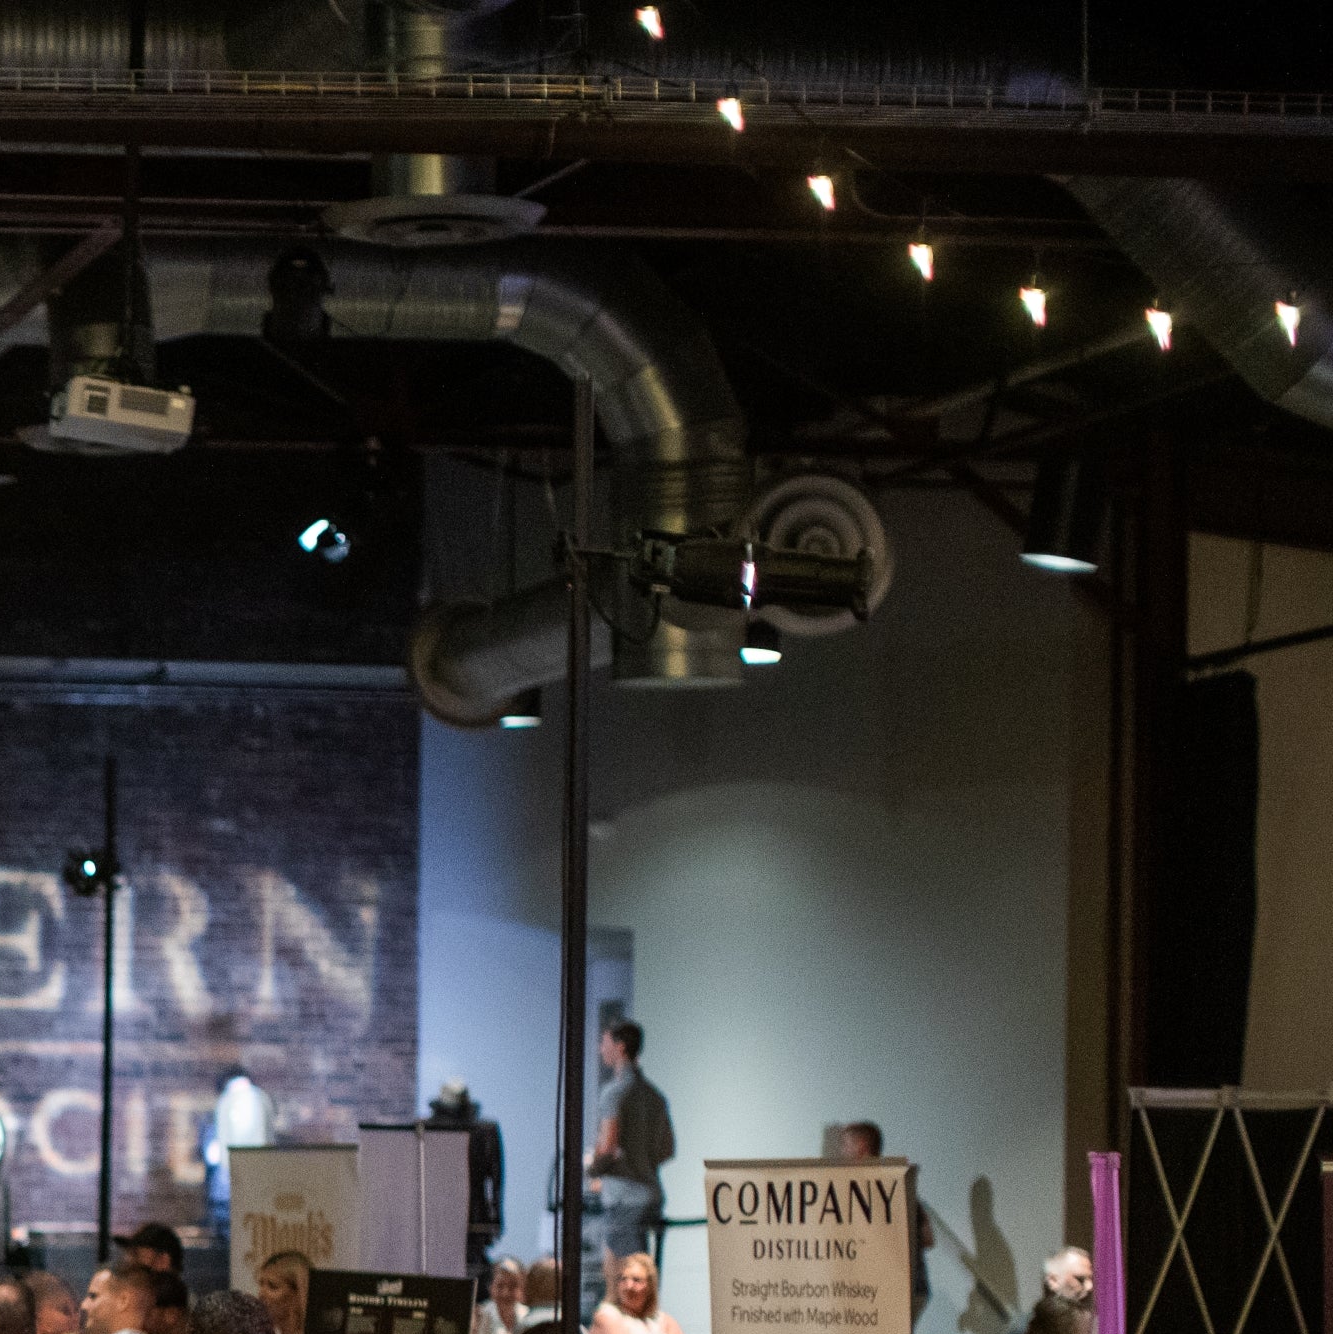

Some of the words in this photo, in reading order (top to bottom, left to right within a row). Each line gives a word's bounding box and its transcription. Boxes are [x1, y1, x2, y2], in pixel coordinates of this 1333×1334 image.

[712, 1179, 897, 1225] COMPANY
[753, 1239, 857, 1260] DISTILLING
[732, 1279, 779, 1299] Straight
[782, 1281, 829, 1298] Bourbon
[832, 1280, 878, 1303] Whiskey
[731, 1306, 781, 1323] Finished
[784, 1307, 804, 1323] with
[807, 1307, 842, 1328] Maple
[843, 1308, 878, 1326] Wood
